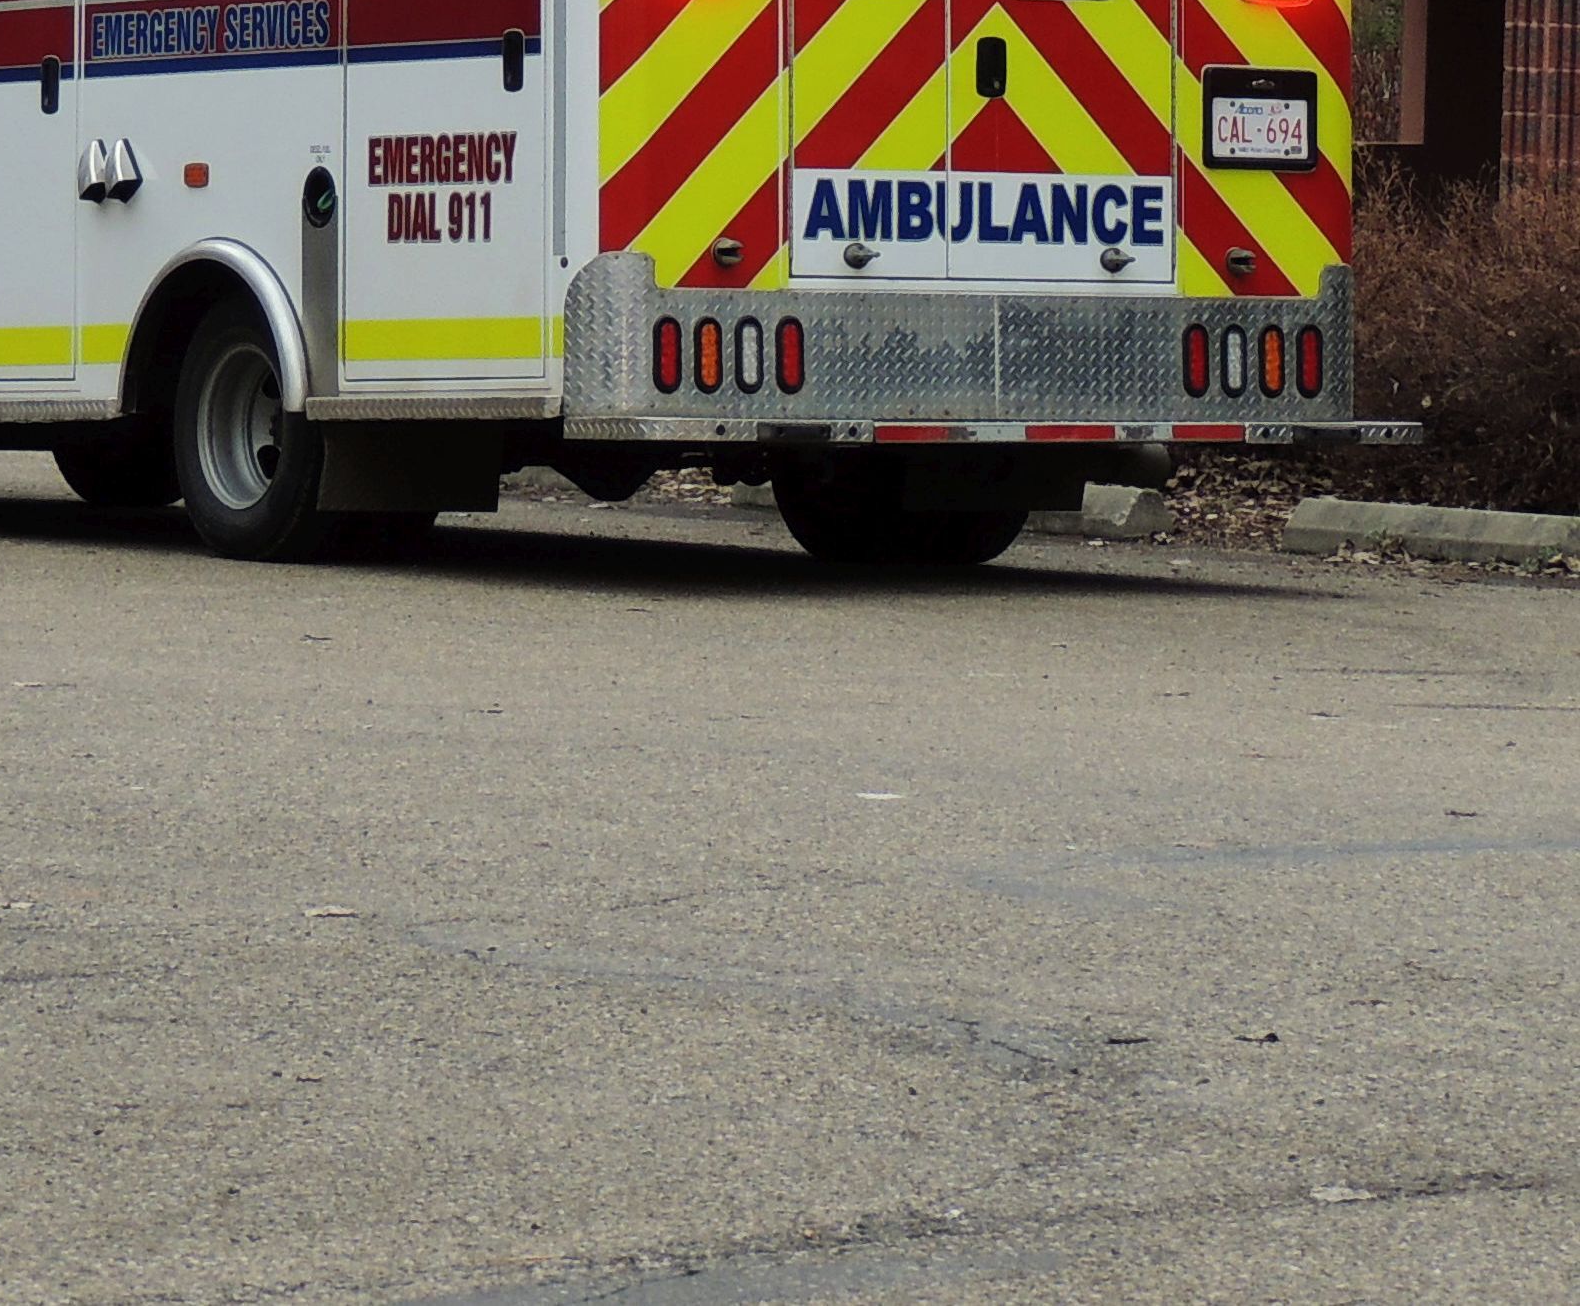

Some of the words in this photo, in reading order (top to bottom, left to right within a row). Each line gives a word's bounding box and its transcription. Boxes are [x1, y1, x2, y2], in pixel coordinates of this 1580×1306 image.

[91, 5, 220, 59] EMERGENCY
[368, 131, 517, 187] EMERGENCY
[387, 191, 442, 244] DIAL
[448, 190, 492, 243] 911
[802, 178, 1165, 246] AMBULANCE
